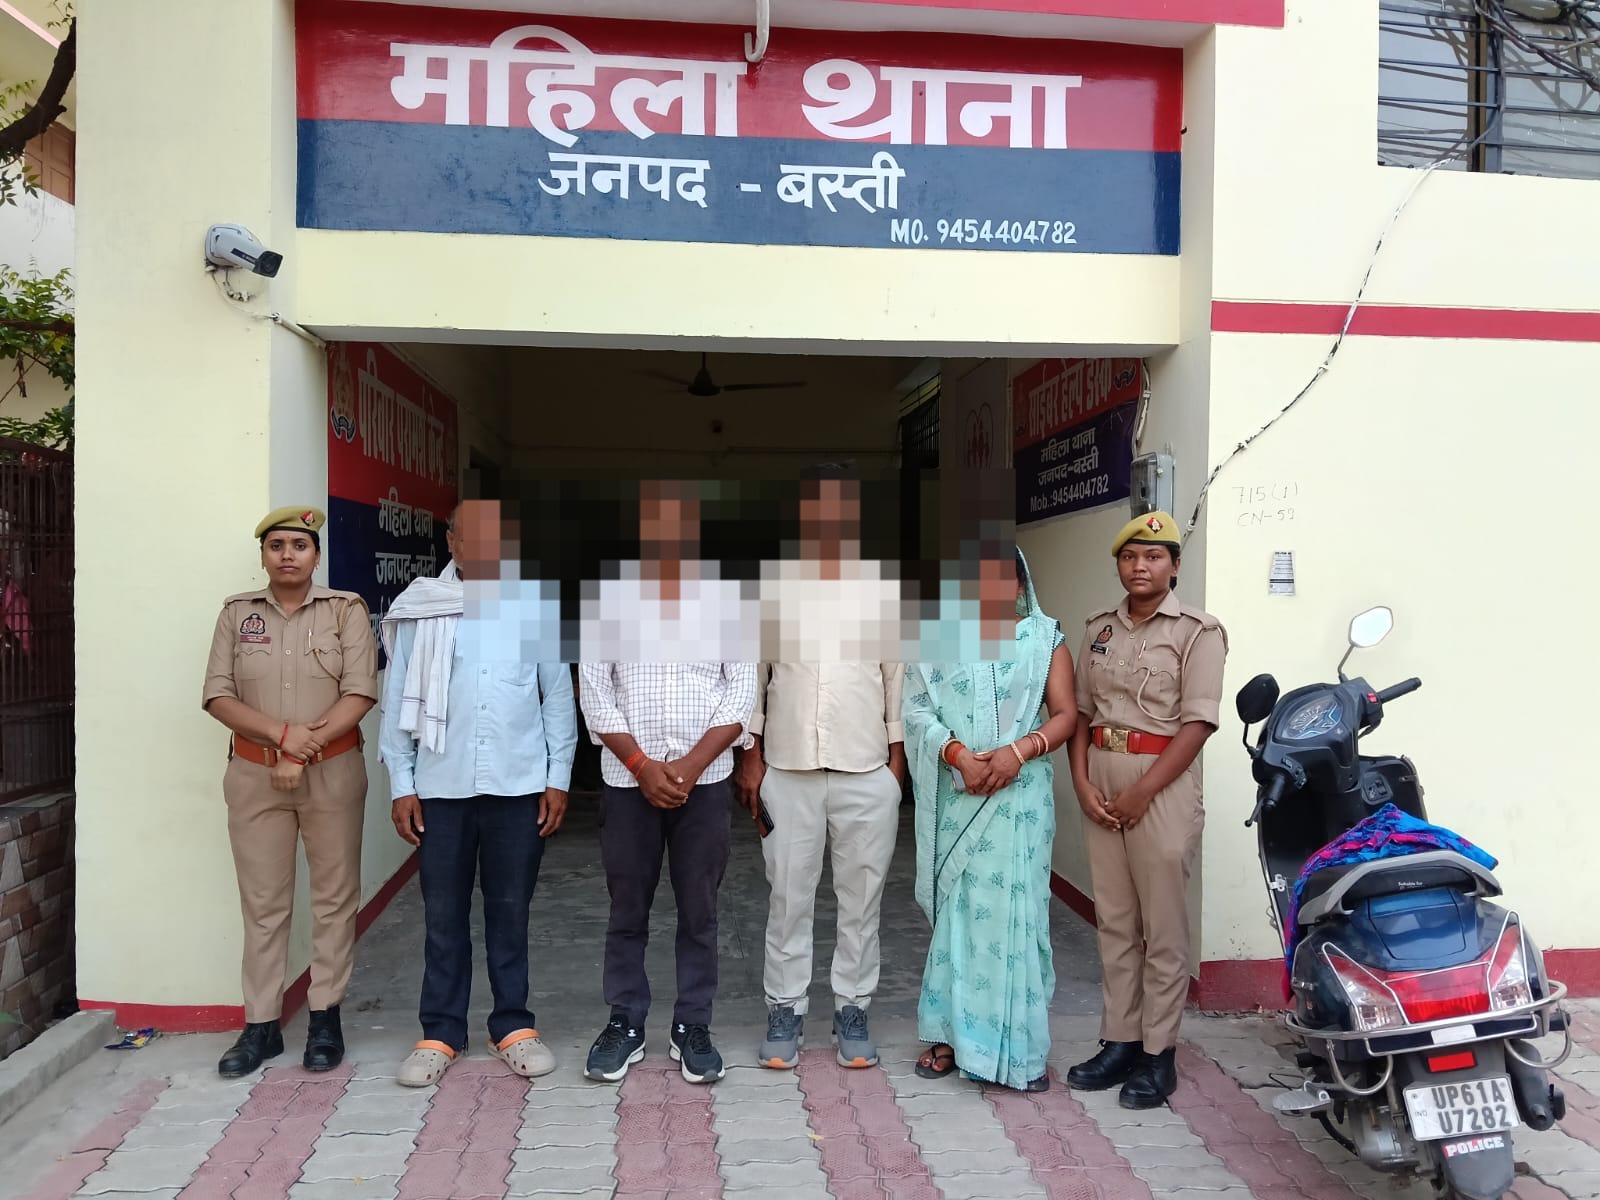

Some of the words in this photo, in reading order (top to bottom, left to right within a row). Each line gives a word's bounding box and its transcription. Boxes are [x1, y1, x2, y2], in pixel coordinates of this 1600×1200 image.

[390, 25, 747, 147] महिला
[801, 59, 1082, 149] थाना
[538, 152, 710, 208] जनपद
[777, 151, 906, 213] बस्ती
[890, 218, 928, 243] MO.
[937, 219, 1076, 245] 9454404782
[358, 347, 395, 466] परिवार
[1040, 438, 1070, 463] महिला
[1071, 427, 1096, 450] थाना
[377, 486, 413, 538] महिला
[414, 508, 434, 539] थाना
[1431, 1080, 1505, 1109] UP61A
[1438, 1104, 1512, 1134] U7282
[1443, 1136, 1505, 1158] POLICE
